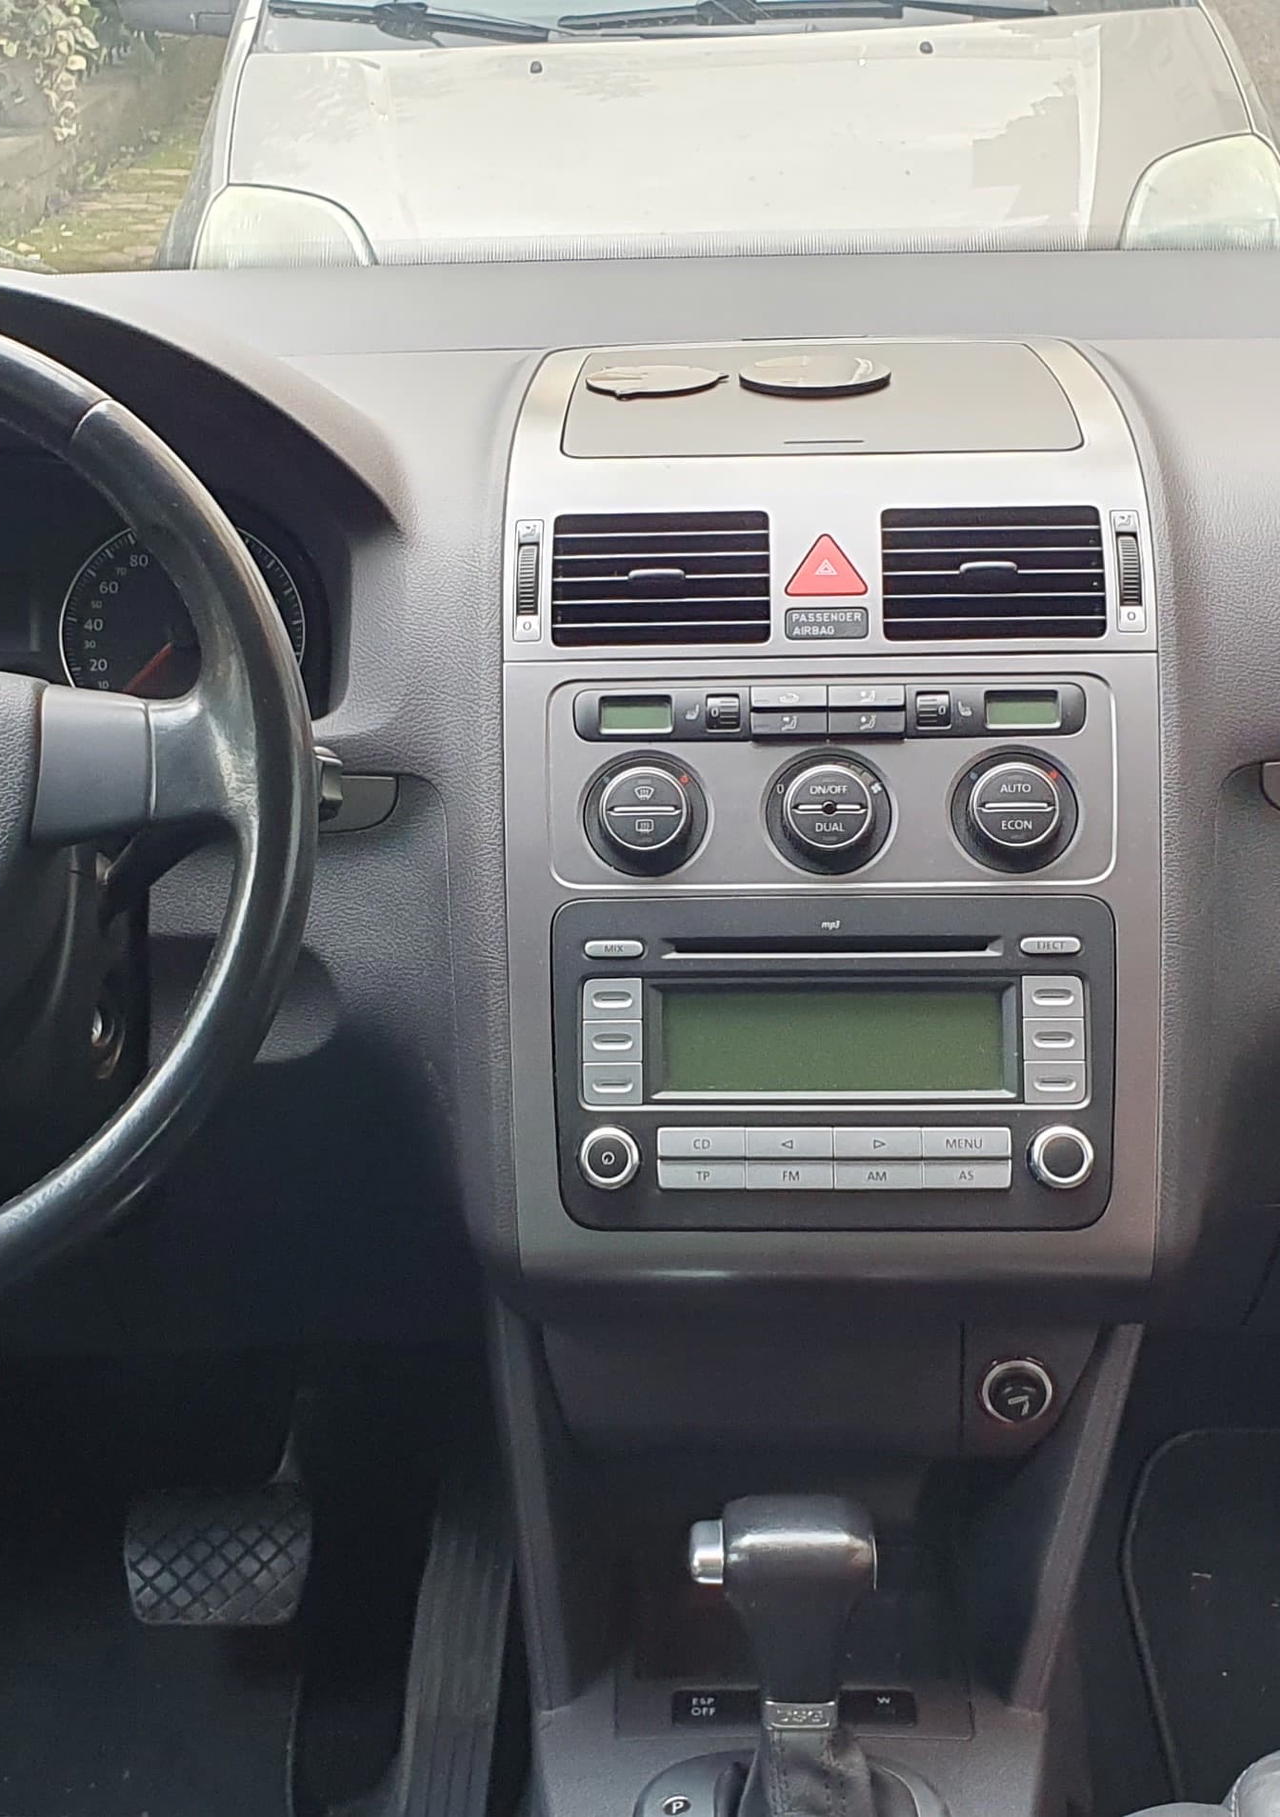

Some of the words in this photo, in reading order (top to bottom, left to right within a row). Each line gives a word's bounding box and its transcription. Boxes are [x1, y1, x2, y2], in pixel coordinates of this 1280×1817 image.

[129, 554, 149, 568] 80
[99, 581, 119, 595] 60
[91, 600, 103, 610] 50
[83, 618, 104, 632] 40
[83, 639, 97, 649] 30
[89, 659, 108, 672] 20
[809, 785, 848, 795] ON/OFF
[1000, 783, 1032, 793] AUTO
[815, 822, 846, 832] DUAL
[1001, 820, 1033, 830] ECON
[821, 920, 841, 930] mp3
[604, 944, 624, 953] MIX
[1036, 940, 1066, 950] EJECT
[692, 1139, 711, 1149] CD
[945, 1138, 984, 1149] MENU
[695, 1170, 711, 1181] TP
[782, 1170, 800, 1181] FM
[867, 1171, 888, 1182] AM
[958, 1170, 975, 1181] AS
[691, 1707, 716, 1717] OFF
[672, 1801, 685, 1814] P
